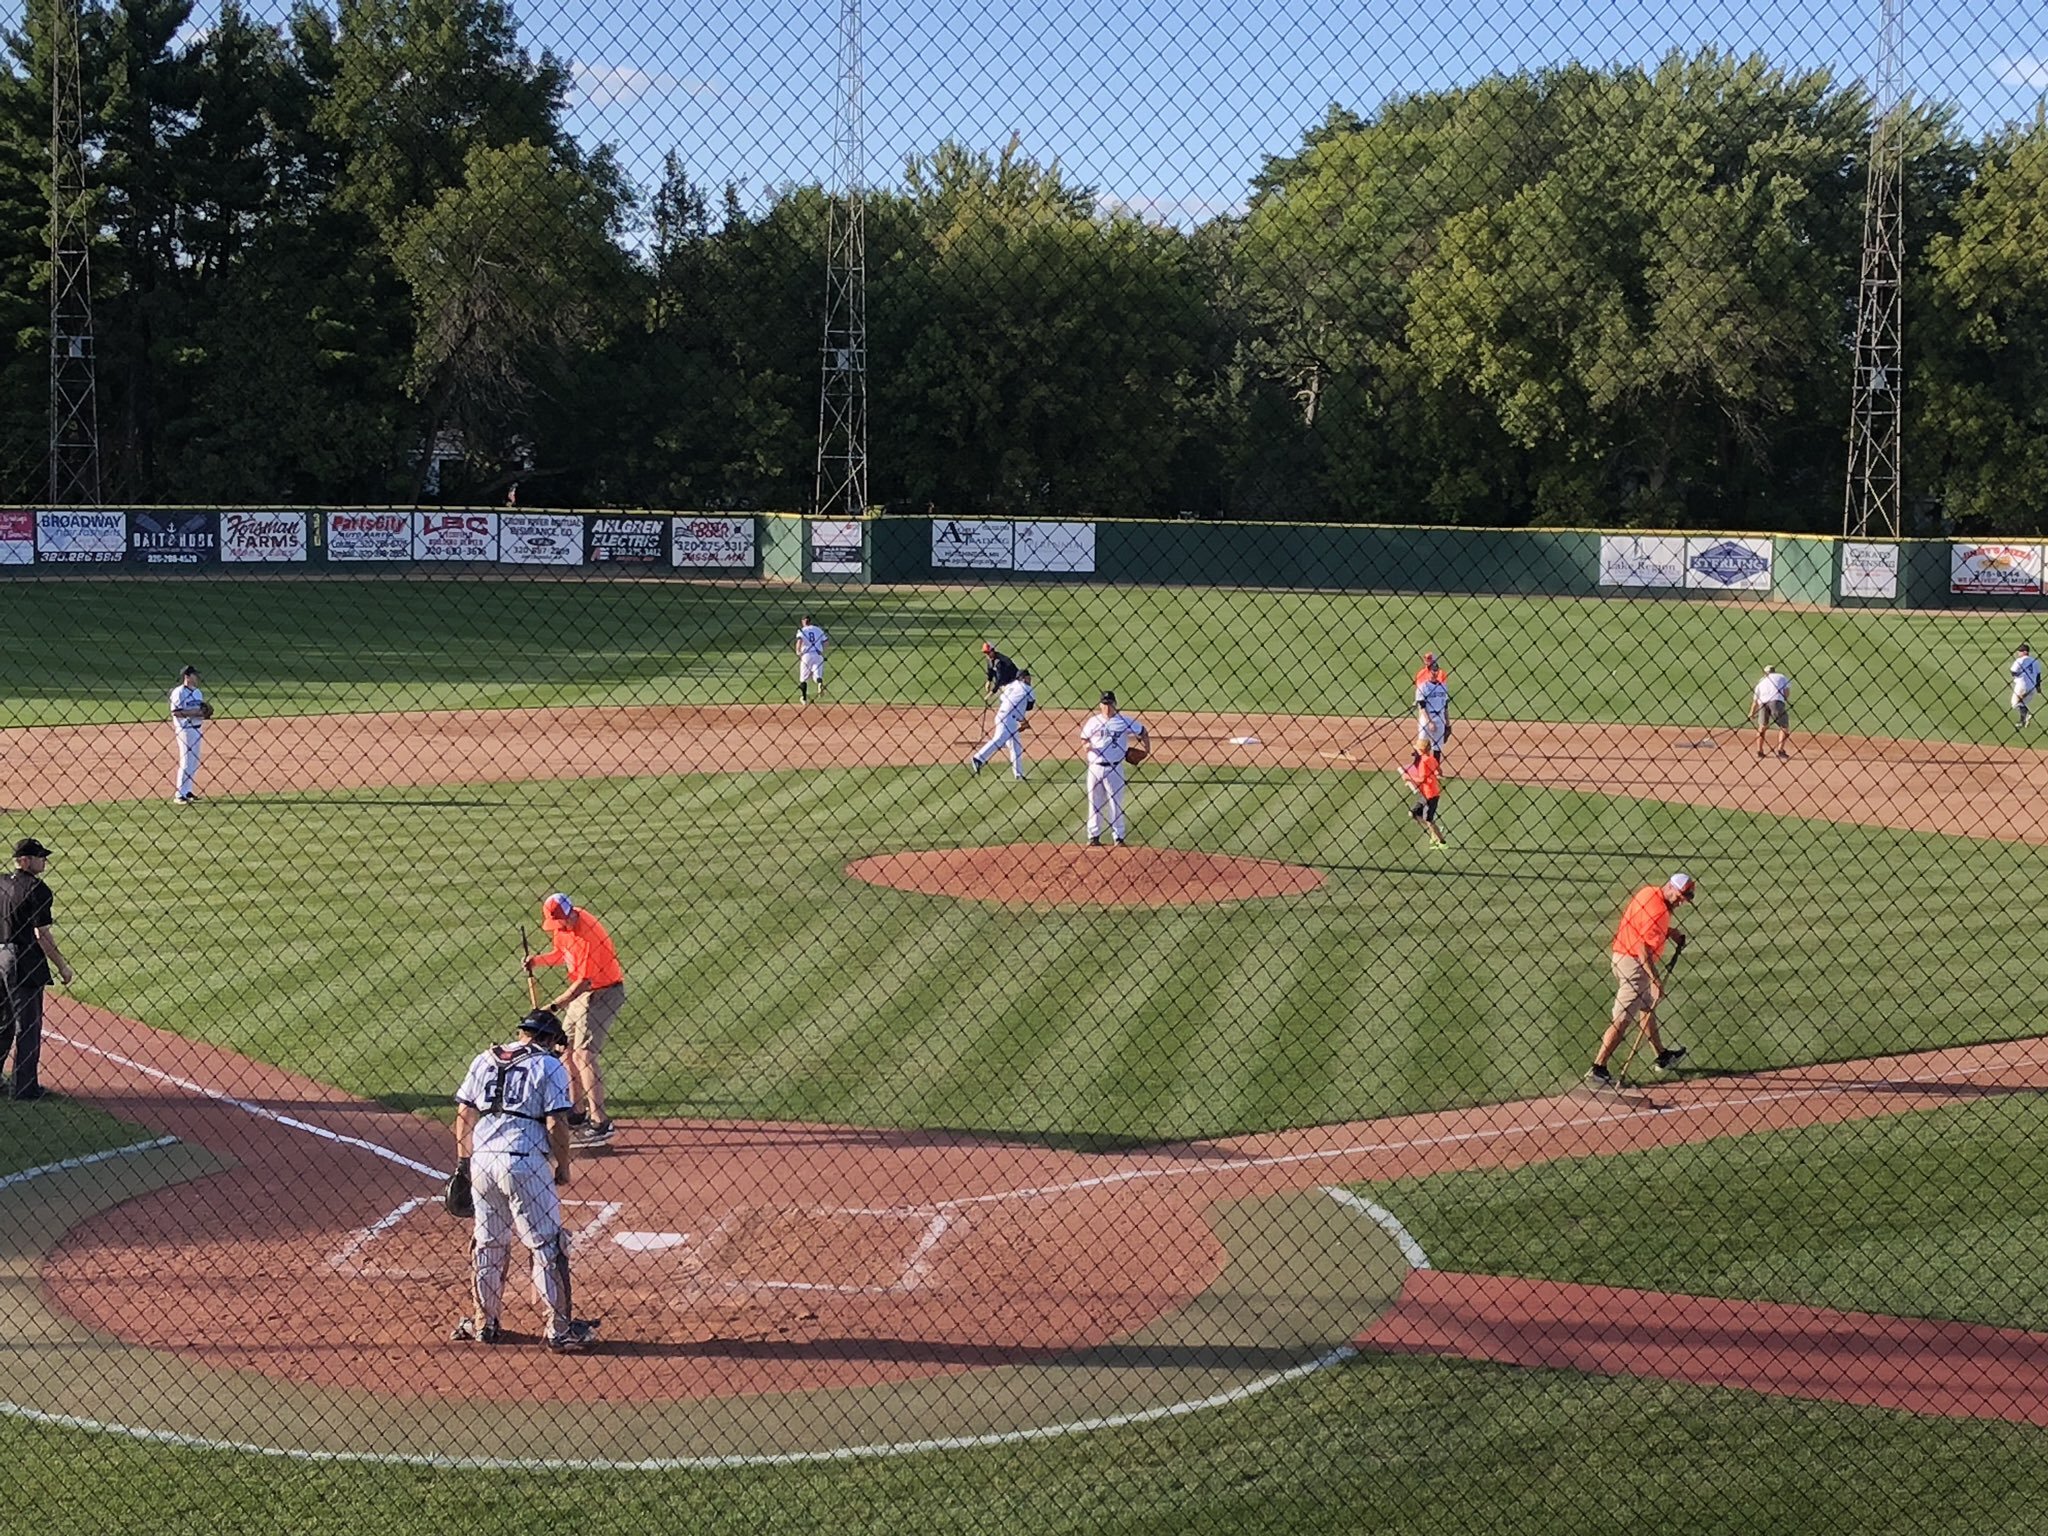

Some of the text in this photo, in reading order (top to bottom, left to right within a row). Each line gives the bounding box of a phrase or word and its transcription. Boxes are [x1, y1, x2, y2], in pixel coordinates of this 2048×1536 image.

[41, 515, 121, 528] BROADWAY
[423, 516, 489, 536] LBC
[591, 519, 664, 534] AHLGREN
[227, 515, 300, 544] Forsman
[133, 532, 166, 547] BAIT
[236, 535, 299, 548] FARMS
[591, 534, 660, 547] ELECTRIC
[1693, 557, 1764, 570] STERLING
[808, 631, 816, 643] 8
